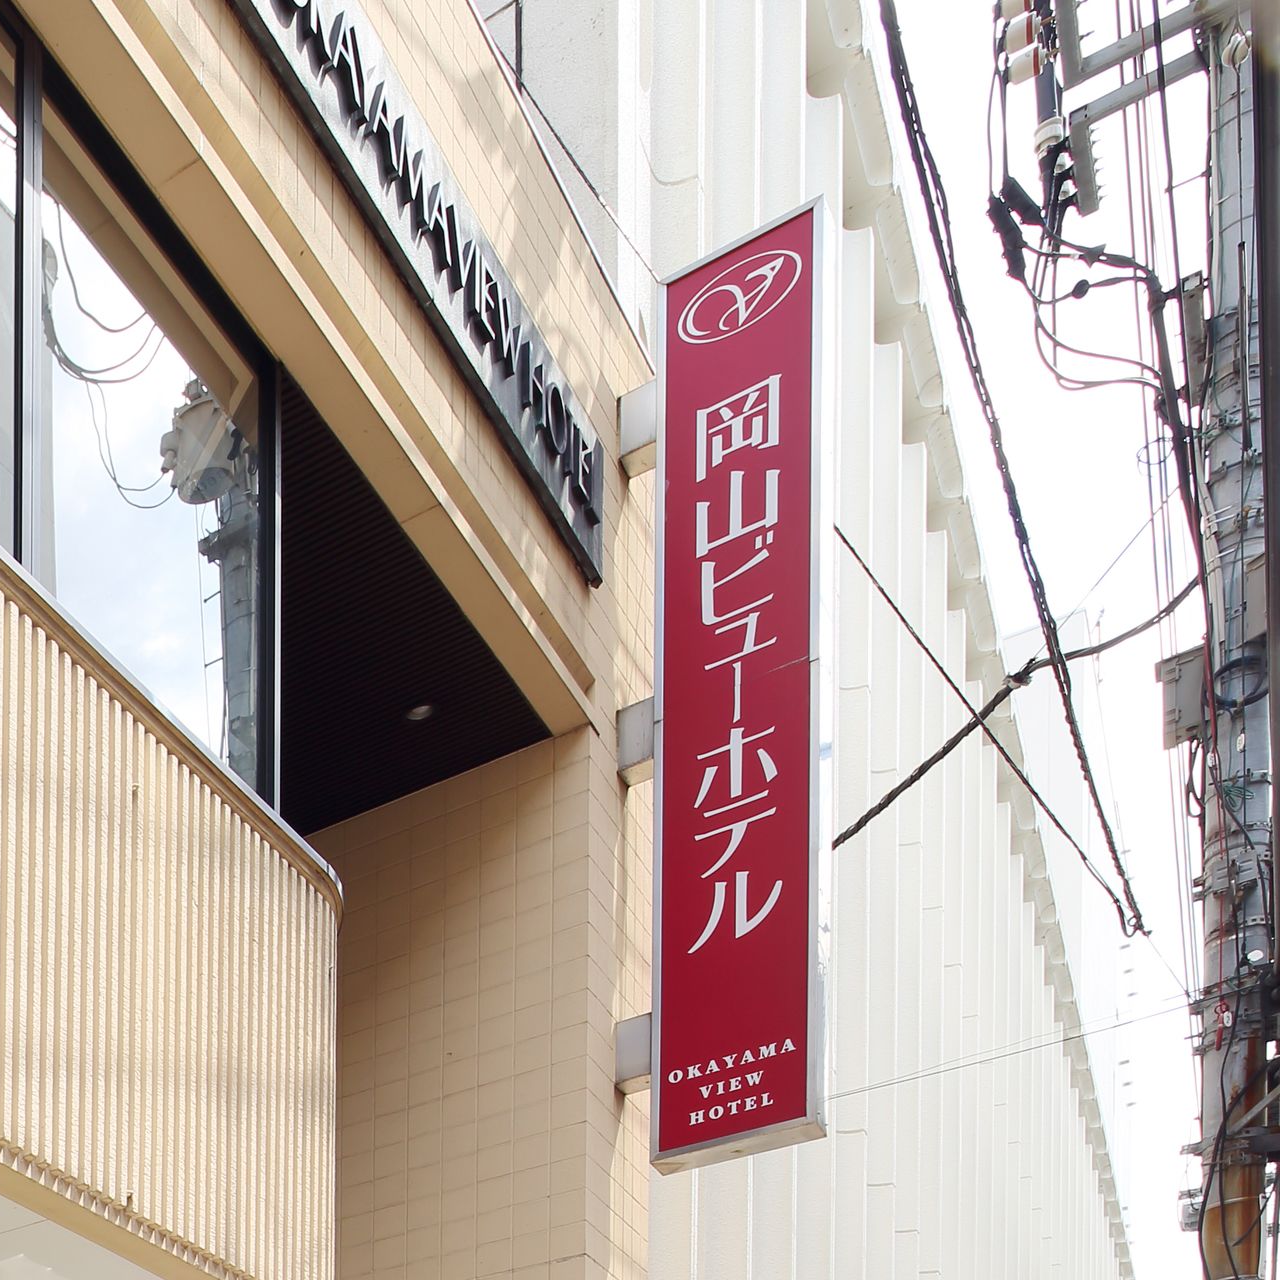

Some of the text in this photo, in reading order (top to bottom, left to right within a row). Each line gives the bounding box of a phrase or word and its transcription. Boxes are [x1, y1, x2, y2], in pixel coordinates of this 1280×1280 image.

[522, 338, 601, 526] HOTEL
[688, 373, 783, 954] 岡山ビューホテル
[668, 1038, 796, 1084] OKAYAMA
[699, 1070, 765, 1099] VIEW
[689, 1093, 773, 1127] HOTEL
